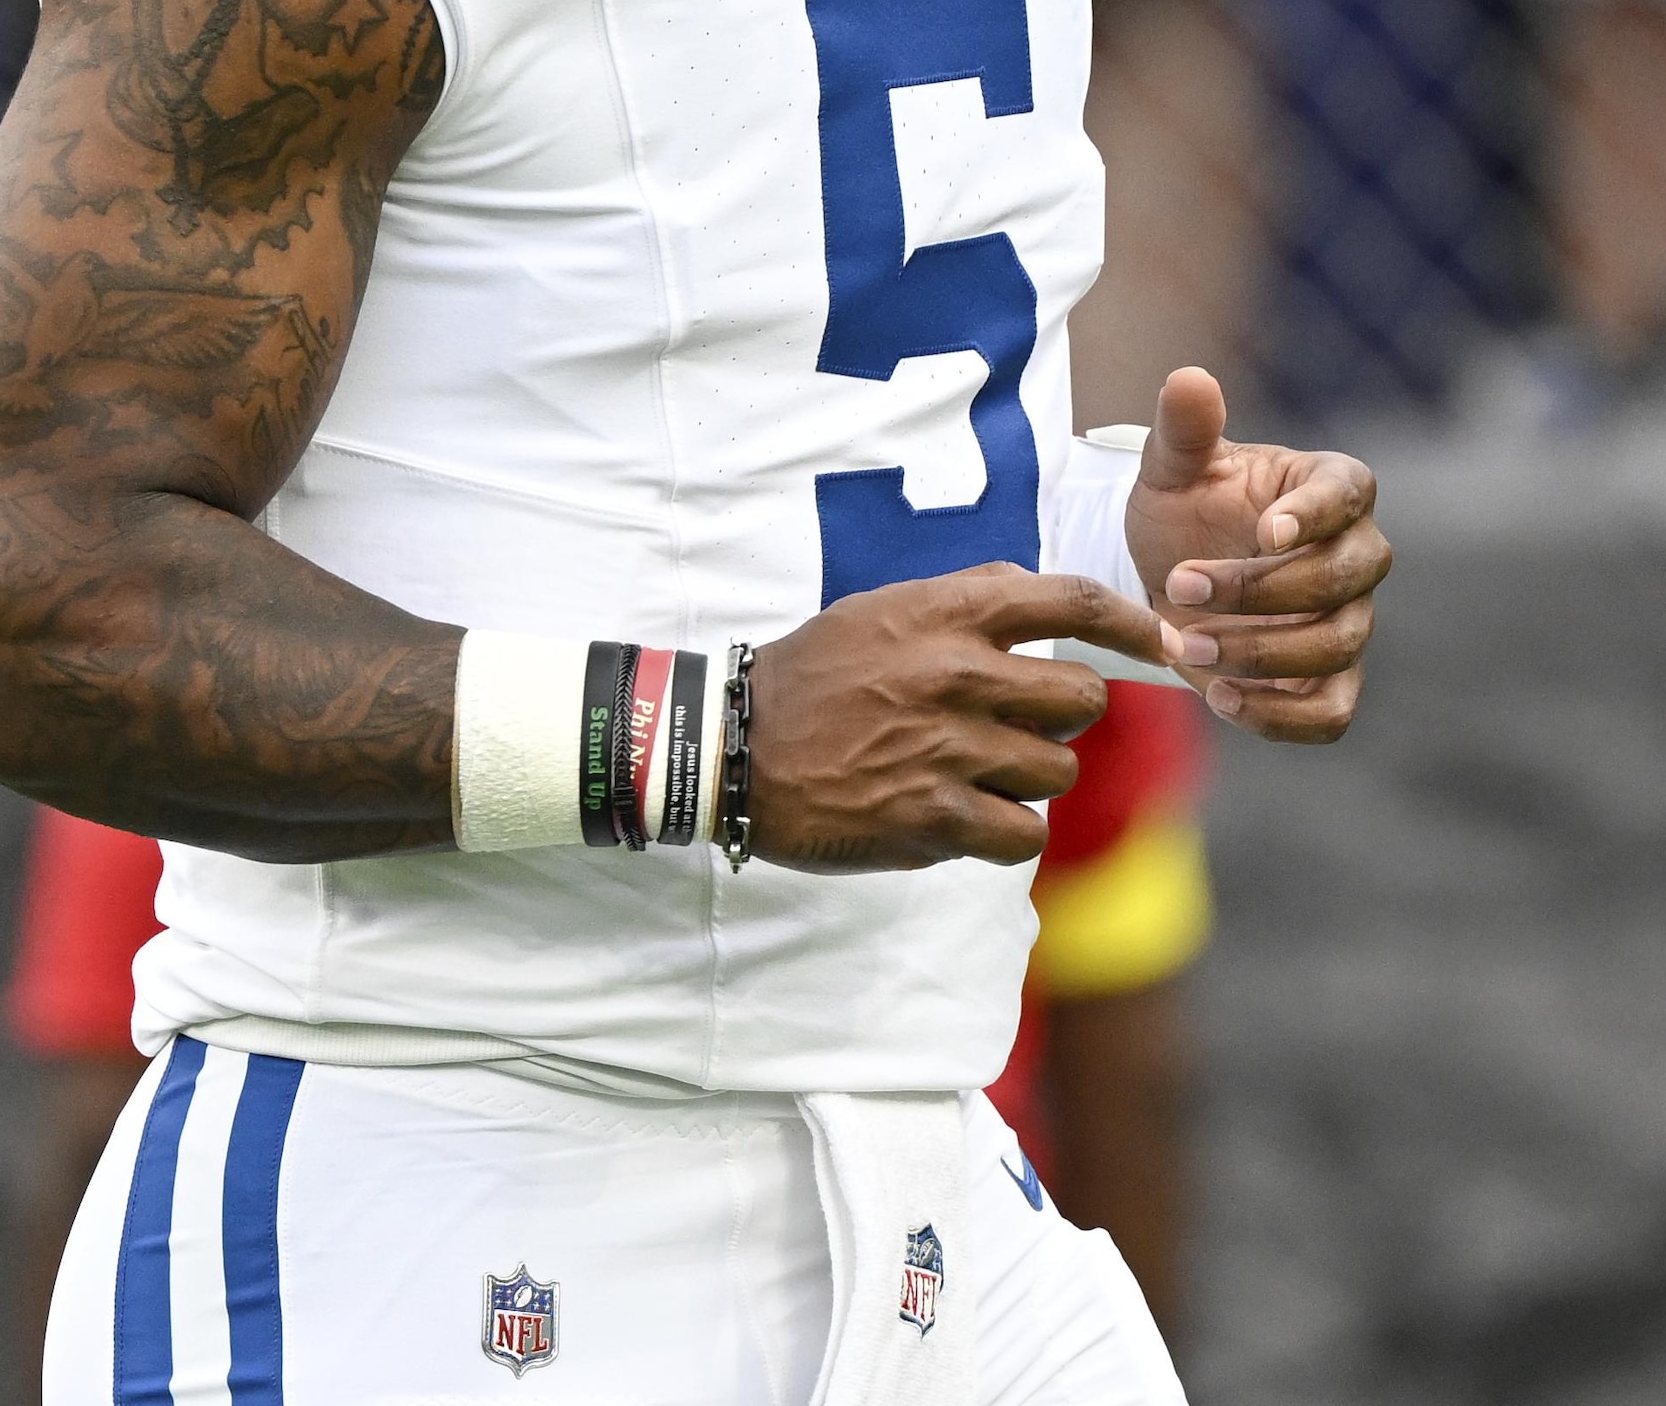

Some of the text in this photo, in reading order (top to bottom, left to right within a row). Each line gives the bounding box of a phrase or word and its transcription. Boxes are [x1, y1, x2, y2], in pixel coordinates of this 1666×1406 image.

[630, 697, 655, 740] Phi
[675, 705, 686, 727] this
[675, 728, 685, 740] is
[585, 706, 609, 811] Stand Up
[670, 740, 684, 807] impossible,
[686, 741, 699, 774] Jesus
[684, 774, 697, 814] looked
[496, 1313, 548, 1356] NFL
